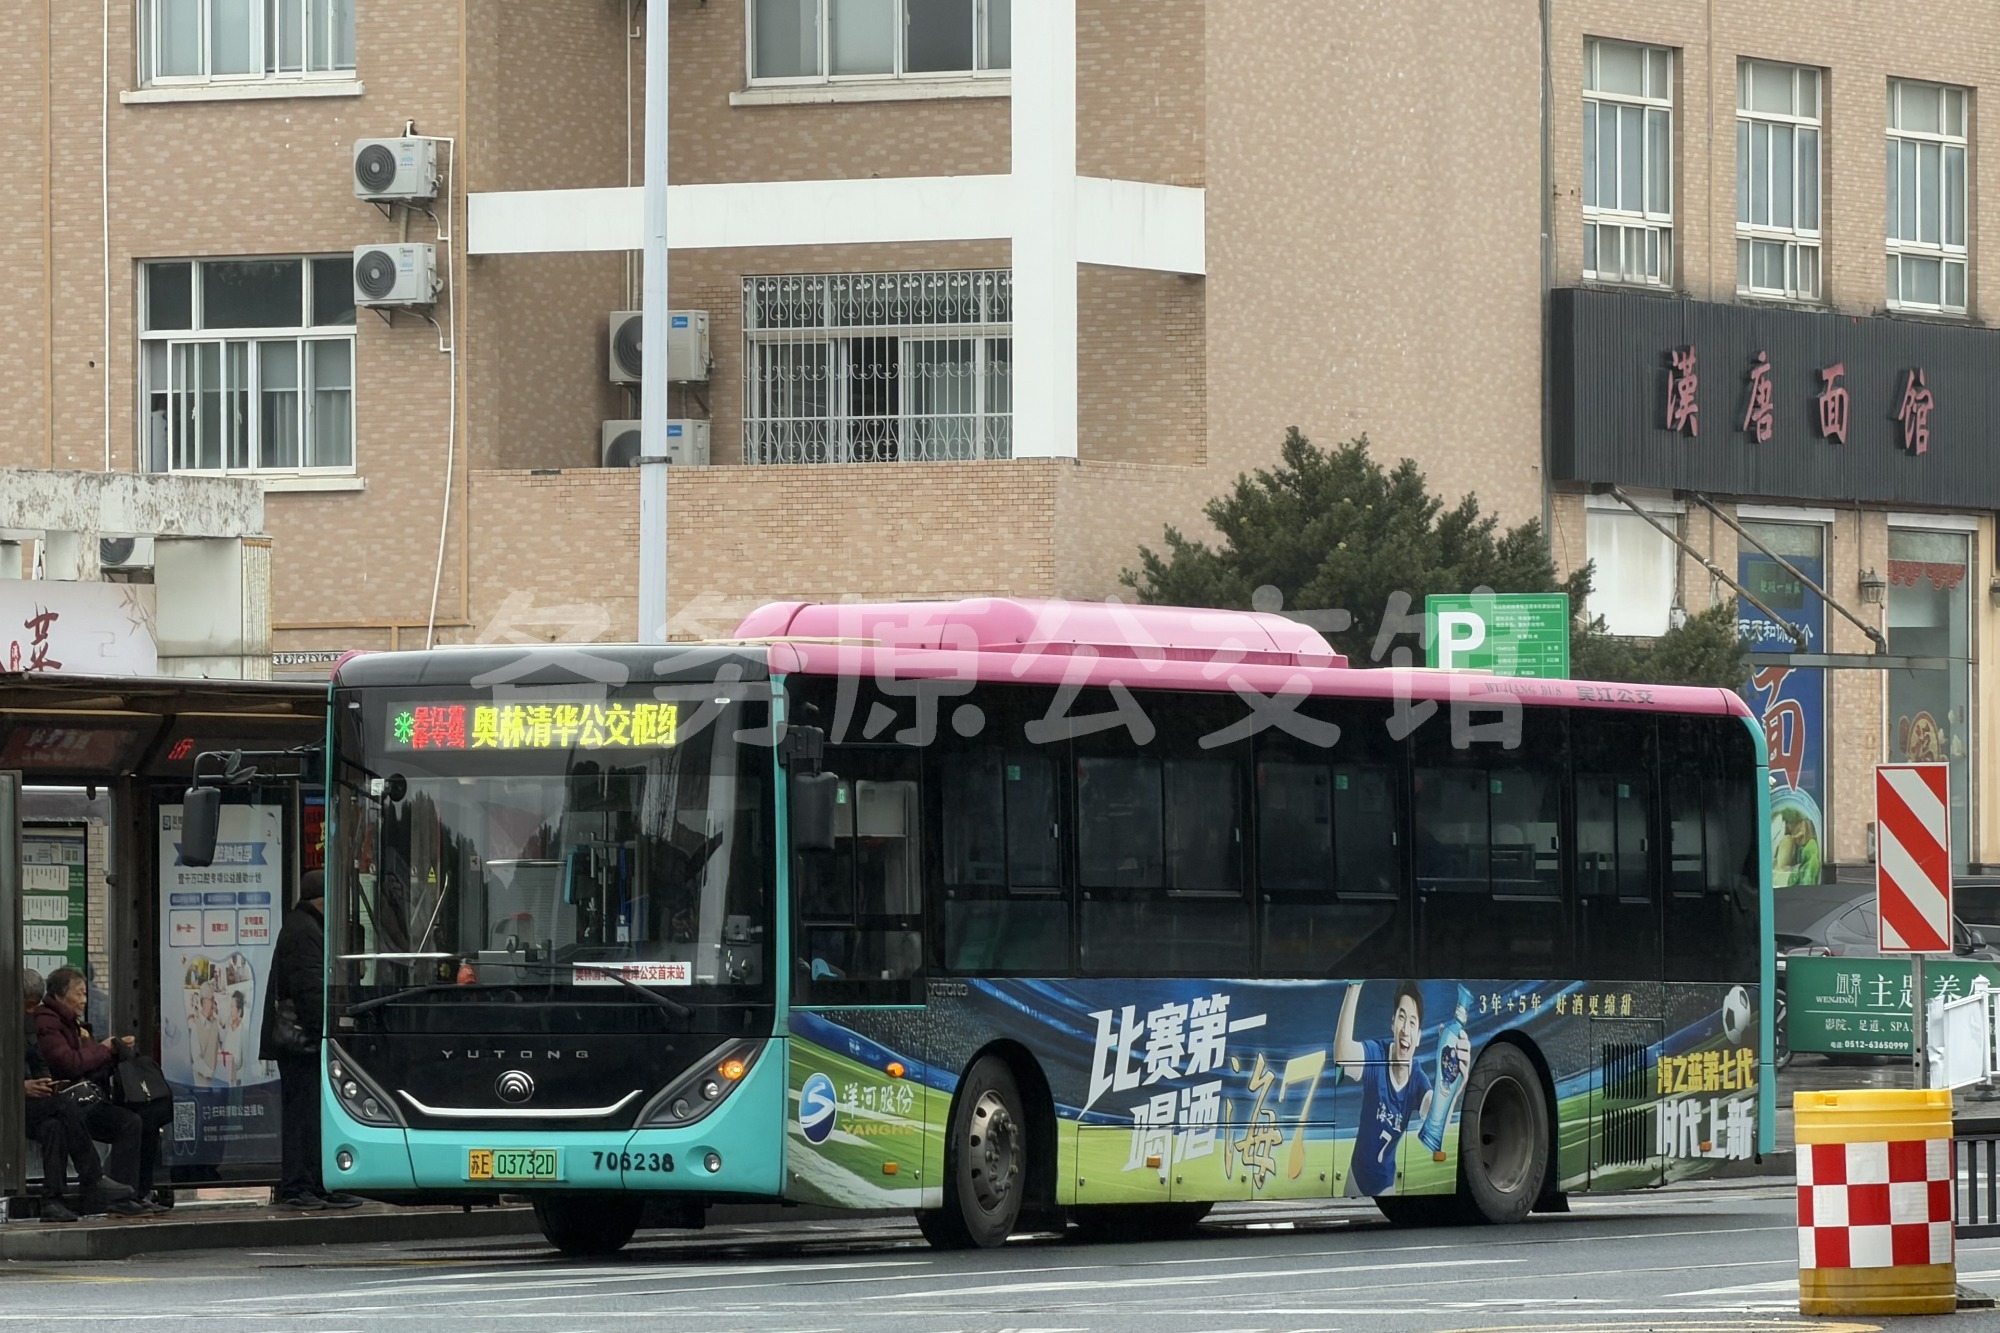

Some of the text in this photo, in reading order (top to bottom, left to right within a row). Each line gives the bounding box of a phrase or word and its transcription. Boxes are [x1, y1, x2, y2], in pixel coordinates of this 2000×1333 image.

[1438, 612, 1486, 670] P
[1576, 686, 1655, 704] 吴江公交
[928, 983, 969, 996] YUTONG
[1816, 995, 1855, 1004] WENJING
[441, 1050, 589, 1059] YUTONG
[1077, 992, 1268, 1121] 比赛第一
[1657, 1048, 1754, 1094] 海之蓝第七代
[842, 1082, 914, 1119] 洋河股份
[1377, 1129, 1393, 1163] 7
[1656, 1098, 1755, 1160] 时代上新
[592, 1151, 675, 1173] 706238
